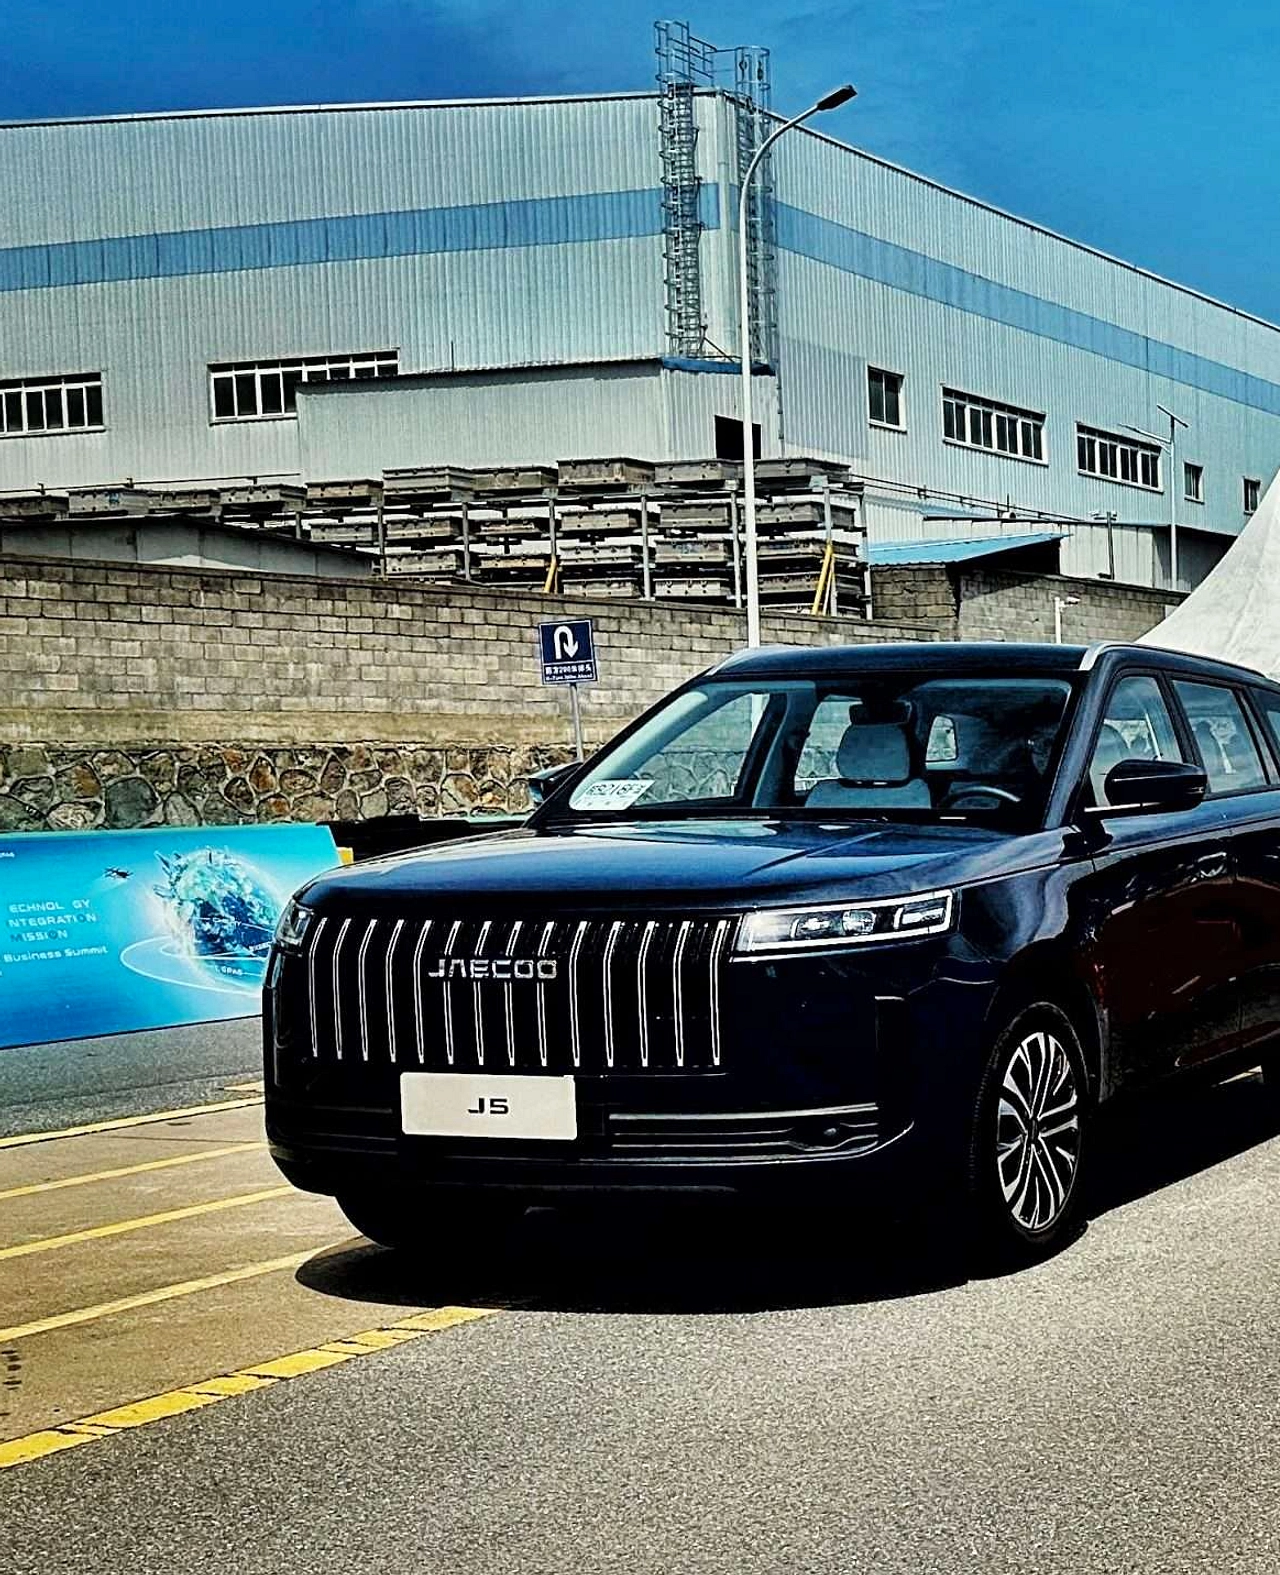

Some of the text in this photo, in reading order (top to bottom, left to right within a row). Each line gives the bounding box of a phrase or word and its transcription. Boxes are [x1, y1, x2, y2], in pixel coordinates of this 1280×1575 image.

[3, 945, 108, 963] Business Summit
[428, 959, 557, 979] JAECOO
[467, 1098, 509, 1114] J5
